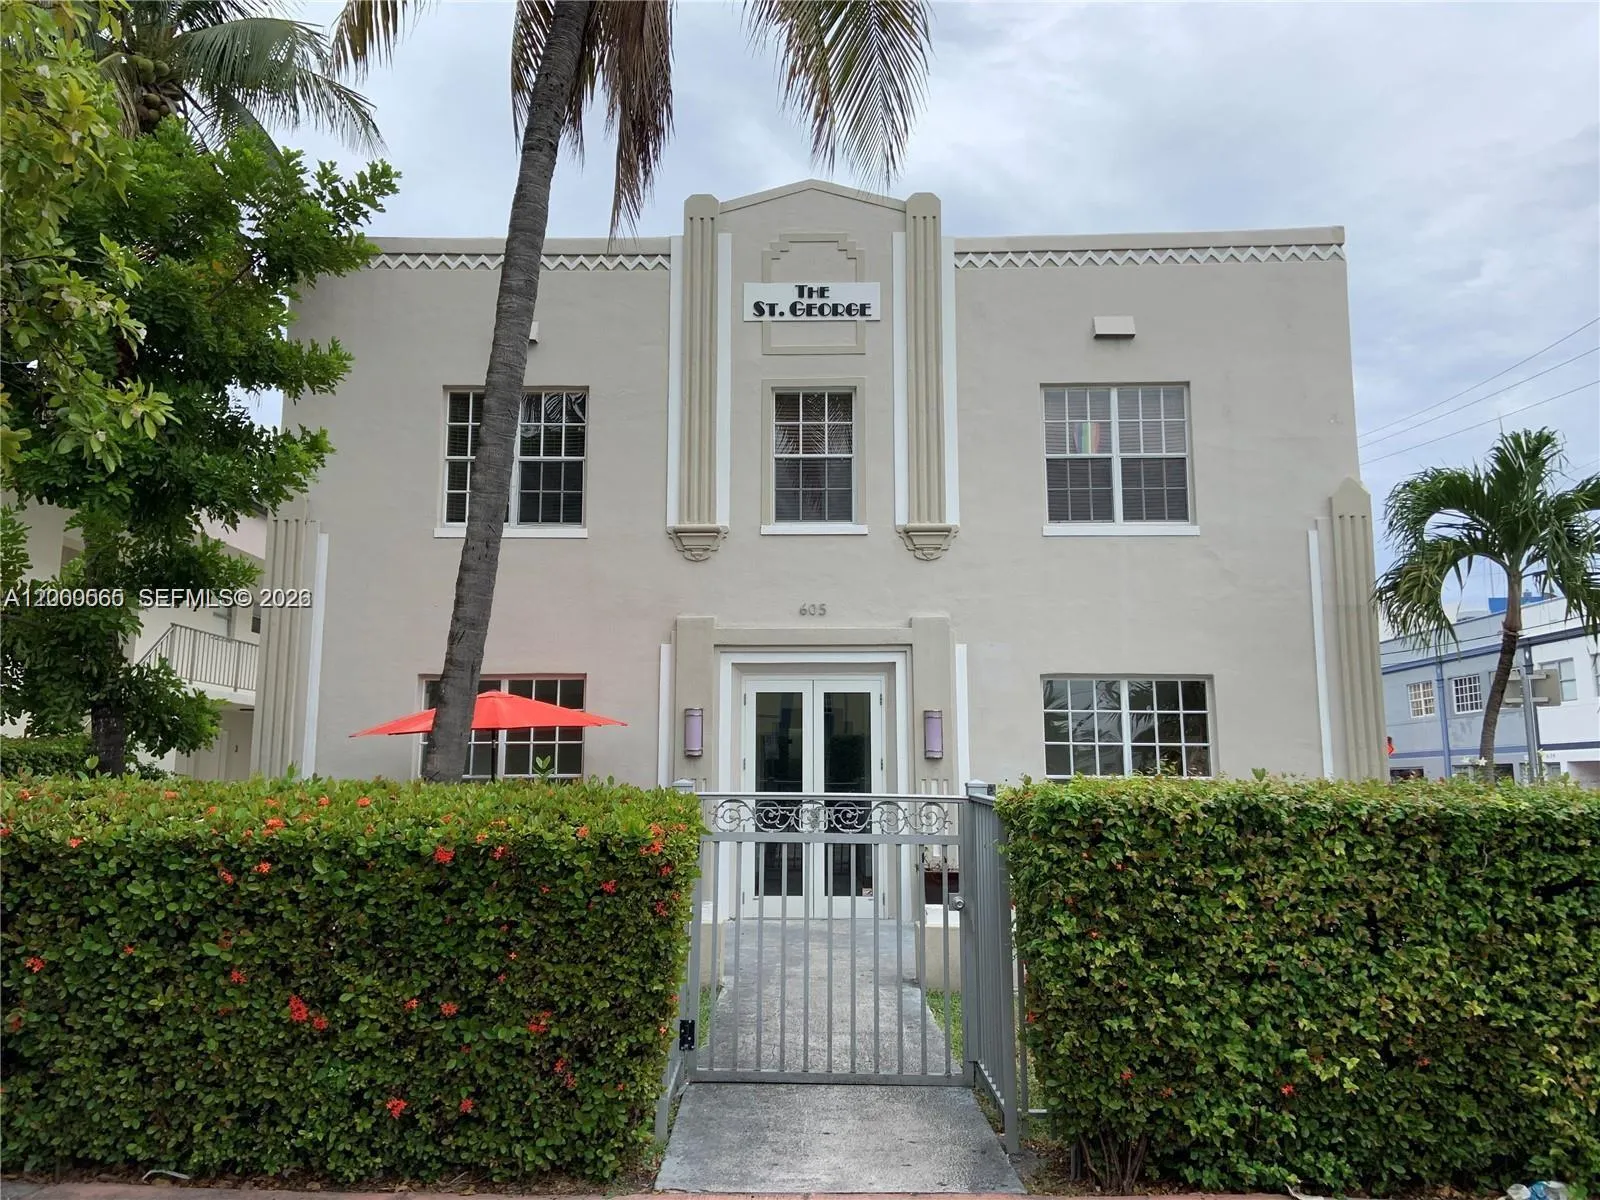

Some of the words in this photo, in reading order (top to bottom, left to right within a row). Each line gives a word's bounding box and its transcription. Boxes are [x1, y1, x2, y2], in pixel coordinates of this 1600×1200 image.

[795, 284, 830, 299] THE
[752, 300, 785, 317] ST.
[789, 300, 872, 317] GEORGE
[799, 602, 827, 617] 605
